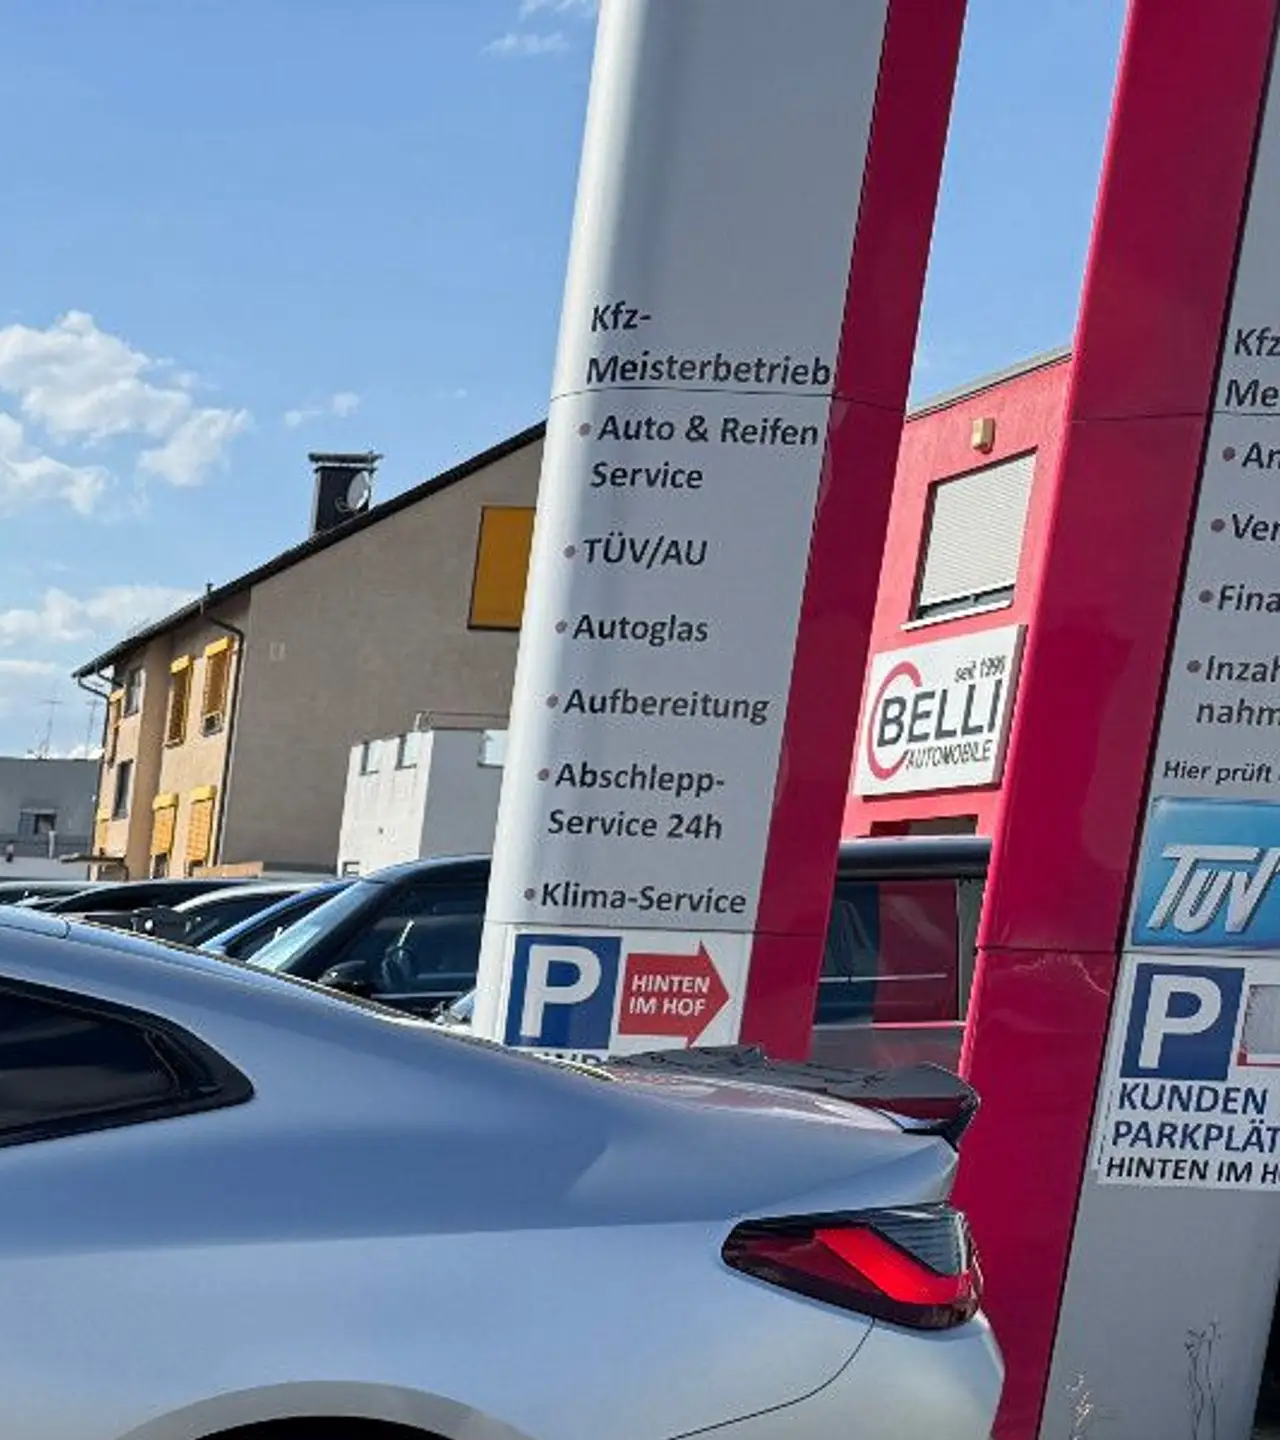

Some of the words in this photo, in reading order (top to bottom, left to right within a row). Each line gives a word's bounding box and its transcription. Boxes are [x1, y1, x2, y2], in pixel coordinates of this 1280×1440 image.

[591, 302, 652, 333] Kfz-
[586, 350, 831, 386] Meisterbetrieb
[597, 414, 675, 442] Auto
[684, 414, 710, 442] &
[720, 416, 819, 446] Reifen
[590, 462, 703, 489] Service
[583, 531, 707, 570] TÜV/AU
[572, 614, 709, 644] Autoglas
[564, 688, 769, 723] Aufbereitung
[877, 679, 1002, 747] BELLI
[906, 740, 993, 769] AUTOMOBILE
[554, 762, 725, 797] Abschlepp-
[1163, 760, 1211, 780] Hier
[1215, 763, 1272, 785] prüft
[548, 811, 657, 838] Service
[666, 813, 722, 840] 24h
[541, 881, 746, 914] Klima-Service
[520, 944, 602, 1038] P
[631, 975, 710, 994] HINTEN
[630, 997, 656, 1014] IM
[662, 998, 706, 1016] HOF
[1138, 974, 1221, 1069] P
[1118, 1082, 1268, 1115] KUNDEN
[1106, 1156, 1208, 1181] HINTEN
[1217, 1160, 1253, 1184] IM
